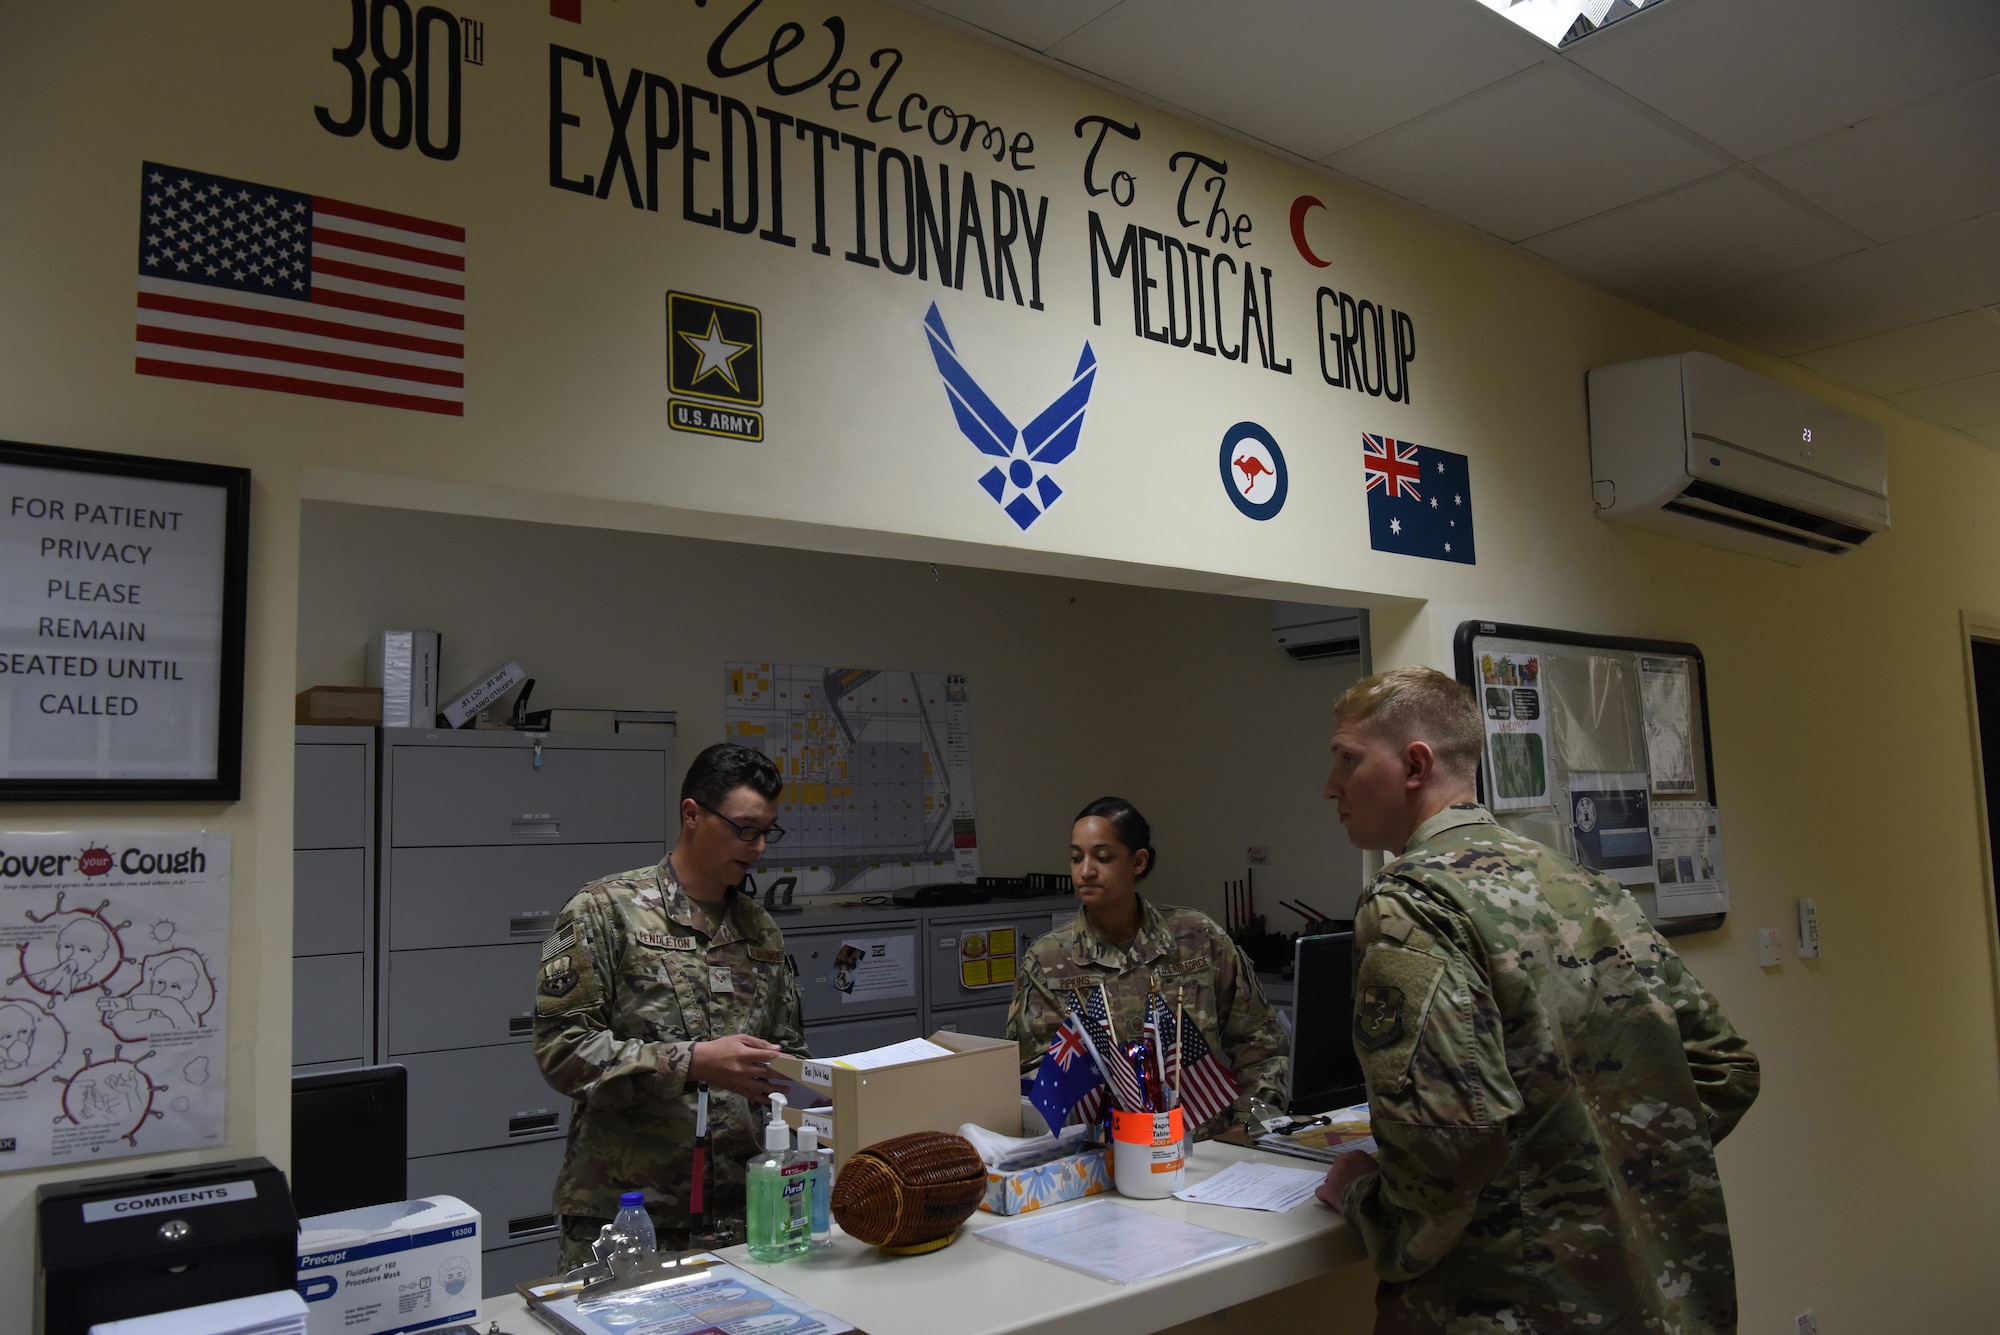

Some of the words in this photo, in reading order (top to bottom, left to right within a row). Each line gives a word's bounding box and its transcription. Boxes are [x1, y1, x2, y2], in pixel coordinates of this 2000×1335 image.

[694, 0, 1035, 171] Welcome
[1074, 115, 1141, 207] To
[1169, 151, 1253, 248] The
[549, 43, 1049, 311] EXPEDITIONARY
[1088, 210, 1292, 375] MEDICAL
[1316, 286, 1416, 404] GROUP
[678, 408, 707, 428] U.S.
[710, 412, 755, 434] ARMY
[11, 496, 65, 520] FOR
[74, 502, 183, 531] PATIENT
[40, 537, 152, 565] PRIVACY
[47, 579, 141, 604] PLEASE
[38, 617, 146, 642] REMAIN
[0, 654, 98, 677] SEATED
[107, 658, 183, 680] UNTIL
[494, 670, 507, 681] APR
[470, 688, 482, 700] OCT
[489, 677, 514, 699] AIRFIELD
[39, 694, 138, 716] CALLED
[464, 696, 489, 718] DRIVING
[82, 854, 109, 868] your
[120, 847, 206, 876] Cough
[640, 932, 691, 949] PENDLETON
[1185, 957, 1209, 971] FORCE
[1060, 976, 1091, 988] PIPKINS
[0, 1140, 14, 1148] DC
[114, 1188, 228, 1213] COMMENTS
[450, 1227, 473, 1238] 15300
[301, 1250, 347, 1268] Precept
[385, 1261, 397, 1271] 160
[345, 1274, 381, 1289] Procedure
[382, 1269, 401, 1280] Mask
